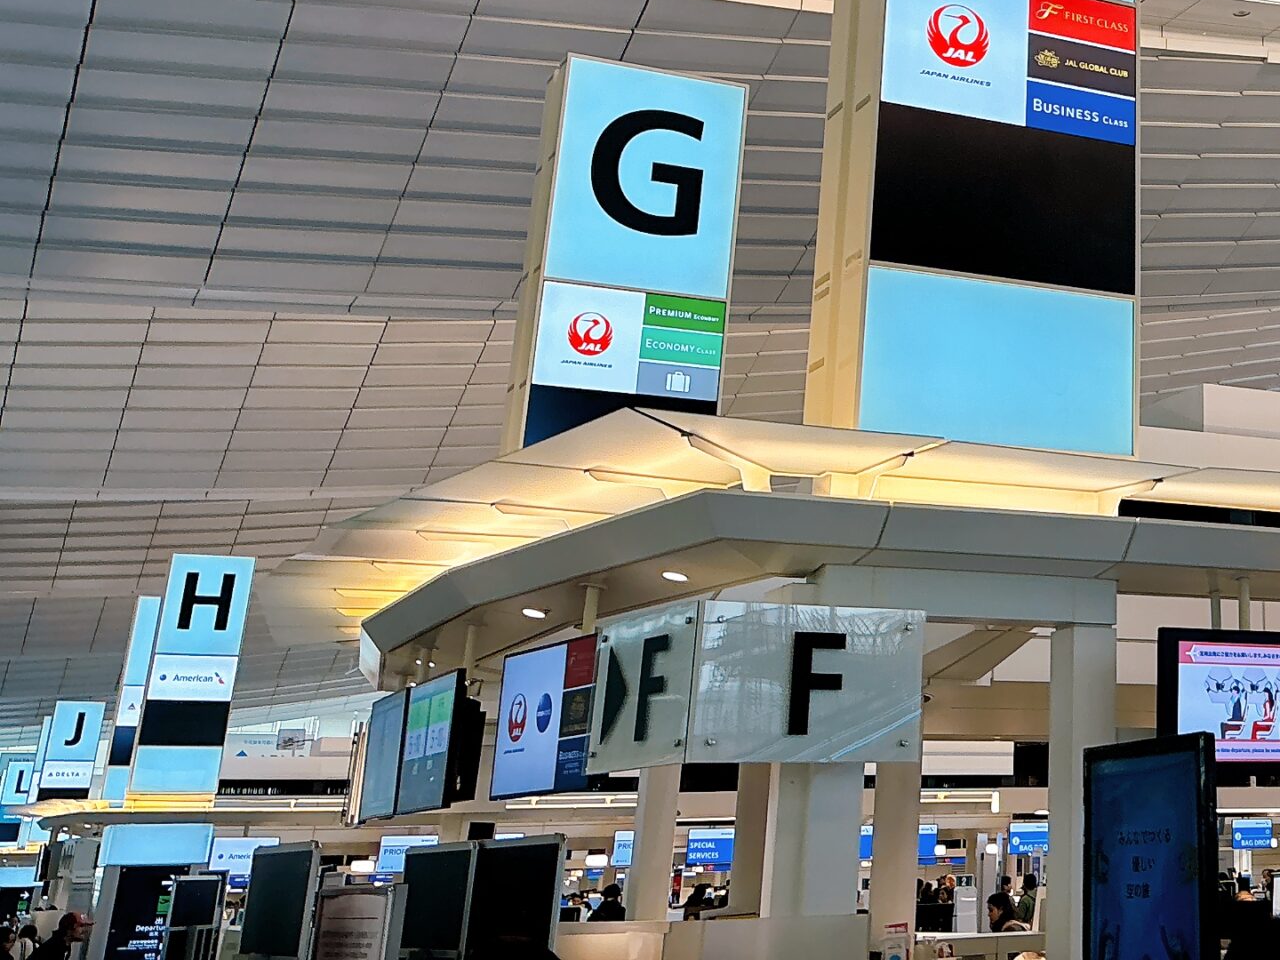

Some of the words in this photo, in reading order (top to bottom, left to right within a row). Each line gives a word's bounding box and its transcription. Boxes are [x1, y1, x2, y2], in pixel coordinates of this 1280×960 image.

[1064, 11, 1094, 25] FIRST
[1097, 18, 1129, 33] CLASS
[943, 47, 976, 63] JAL
[1065, 58, 1078, 68] JAL
[1079, 61, 1108, 75] GLOBAL
[1109, 67, 1129, 78] CLUB
[919, 69, 949, 79] JAPAN
[950, 75, 991, 87] AIRLINES
[1033, 97, 1099, 122] BUSINESS
[1103, 115, 1129, 128] CLASS
[590, 109, 705, 236] G
[649, 305, 692, 319] PREMIUM
[578, 342, 603, 352] JAL
[646, 338, 695, 352] ECONOMY
[176, 571, 236, 631] H
[172, 674, 214, 683] American
[633, 633, 670, 742] F
[787, 631, 847, 736] F
[64, 712, 86, 746] J
[15, 770, 29, 793] L
[689, 841, 716, 849] SPECIAL
[688, 851, 719, 859] SERVICES
[961, 877, 967, 886] 2
